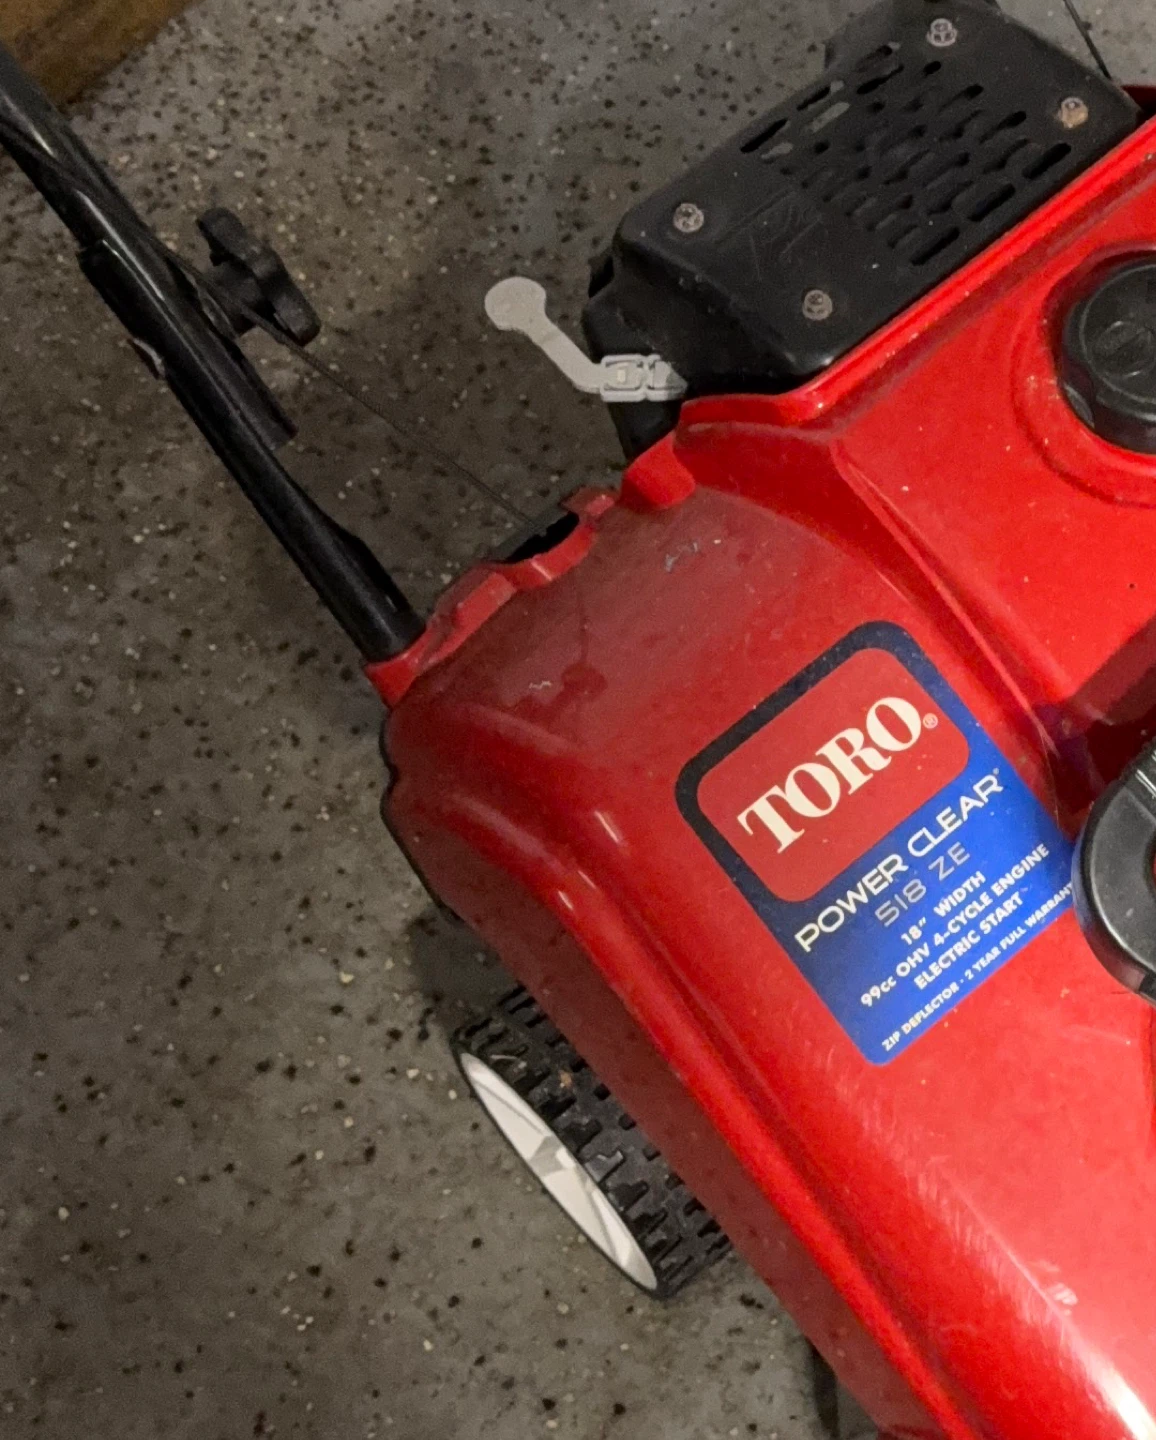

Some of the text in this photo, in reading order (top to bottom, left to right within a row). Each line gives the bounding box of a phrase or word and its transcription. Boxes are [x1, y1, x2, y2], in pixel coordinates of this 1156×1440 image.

[737, 697, 922, 853] TORO
[794, 773, 1004, 952] POWER CLEAR
[860, 844, 1049, 1007] 99cc OHV 4-CYCLE ENGINE
[928, 841, 970, 880] ZE
[933, 871, 986, 918] WIDTH
[881, 883, 1073, 1052] ZIP DEFLECTOR 2 YEAR FULL WARRANT
[914, 892, 1024, 990] ELECTRIC START
